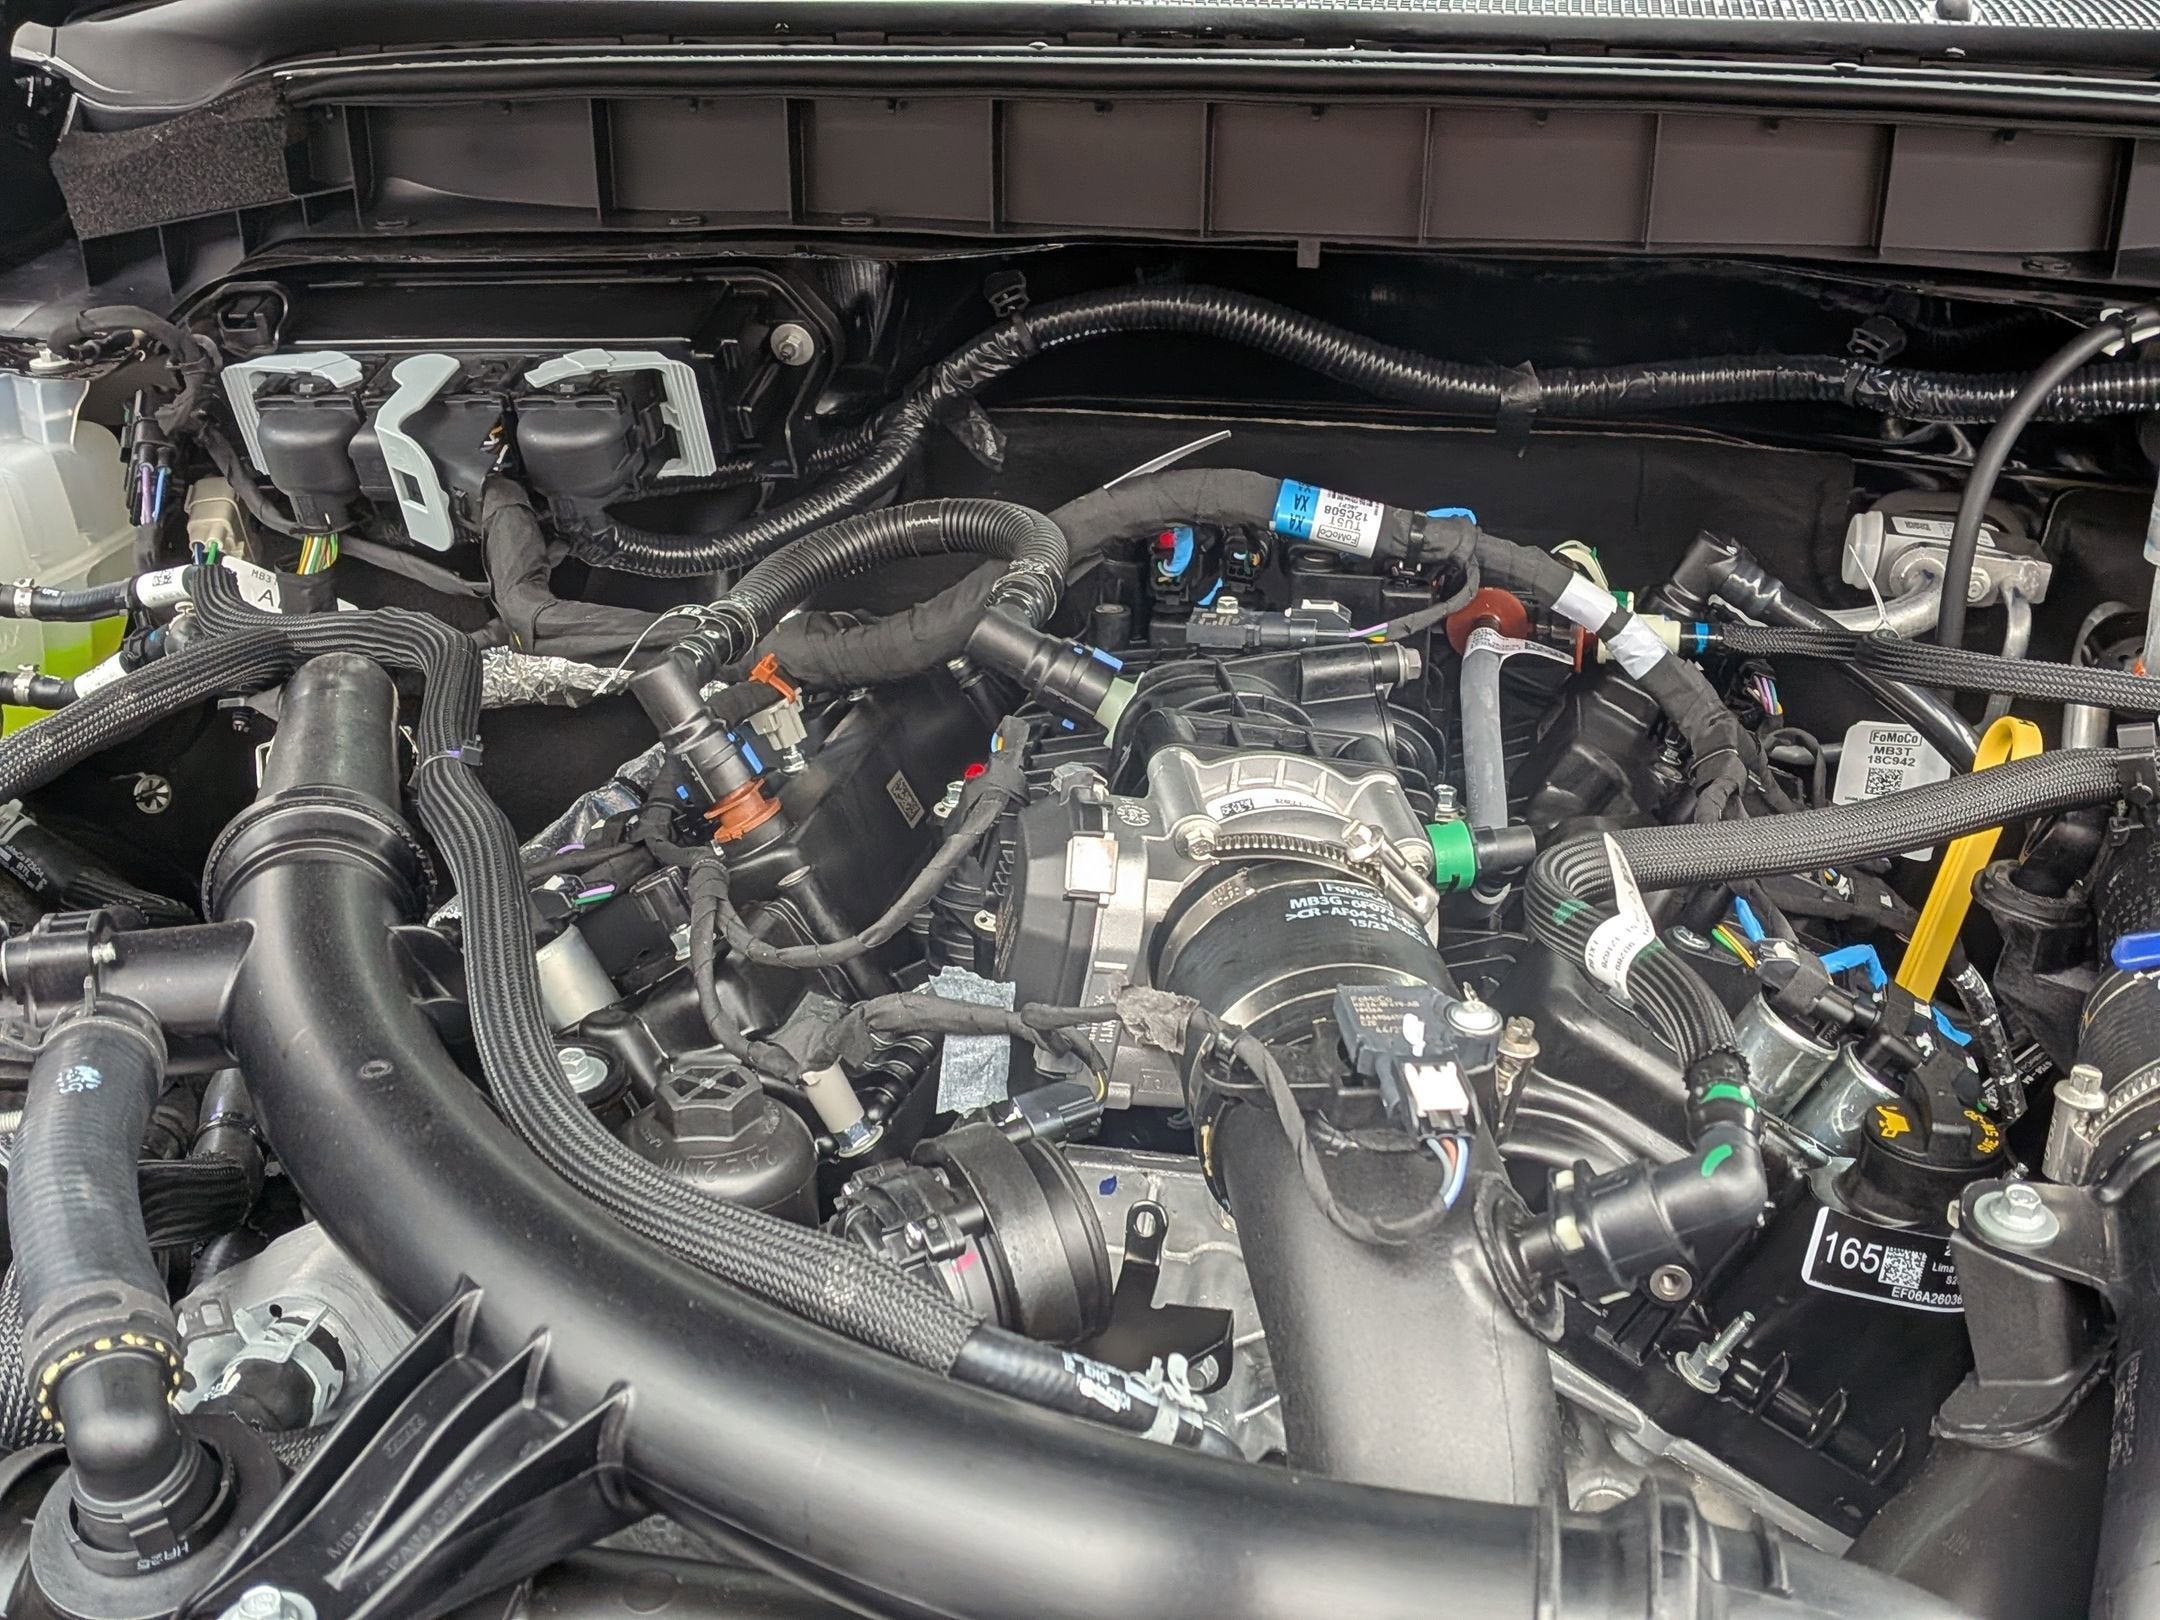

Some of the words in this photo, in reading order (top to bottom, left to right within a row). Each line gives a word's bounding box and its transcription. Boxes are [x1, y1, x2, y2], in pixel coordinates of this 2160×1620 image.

[1294, 493, 1310, 512] XA
[1324, 505, 1368, 522] 12C508
[1328, 516, 1361, 532] TU5T
[1318, 528, 1359, 545] FoMoCo
[258, 589, 274, 607] A
[1872, 731, 1919, 744] FoMoCo
[1873, 746, 1913, 756] MB3T
[1867, 755, 1916, 767] 18C942
[1326, 883, 1387, 905] FoMoCo
[1348, 918, 1390, 932] 15/23
[1825, 1231, 1883, 1274] 165
[1932, 1261, 1955, 1274] Lima
